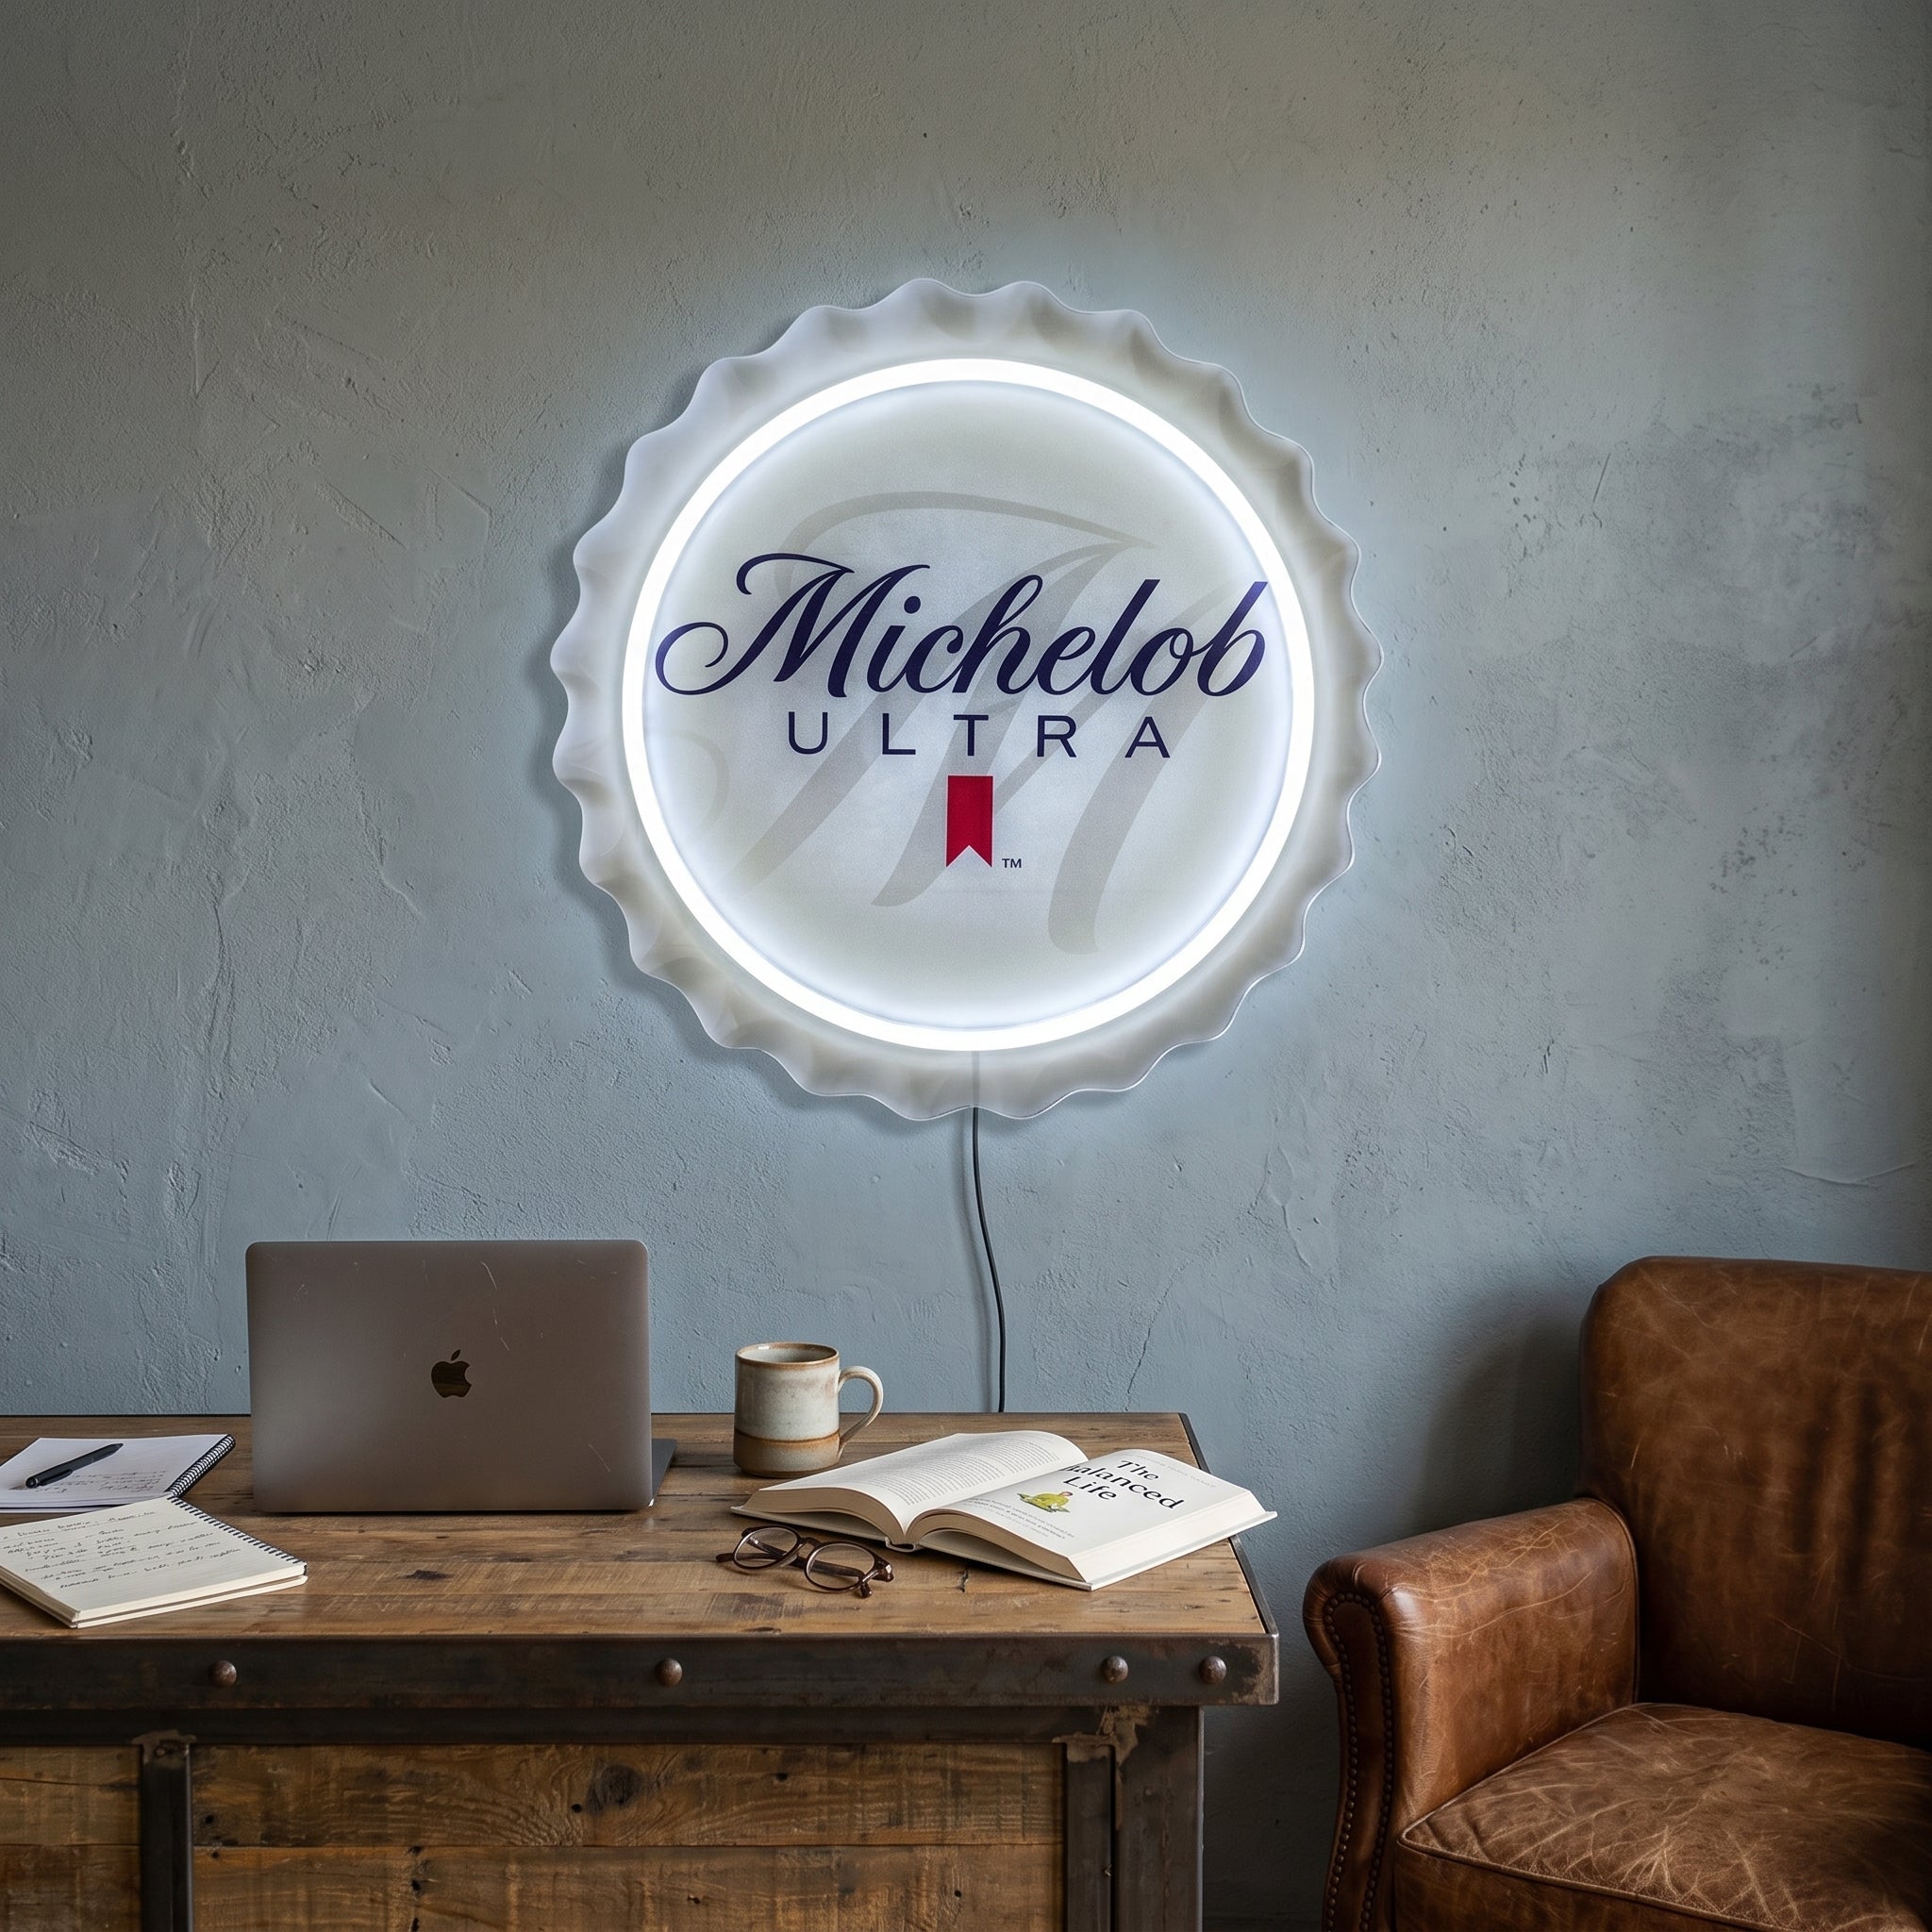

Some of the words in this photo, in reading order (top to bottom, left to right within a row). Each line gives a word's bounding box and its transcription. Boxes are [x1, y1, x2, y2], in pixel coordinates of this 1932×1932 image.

[655, 552, 1268, 698] Michelob
[788, 710, 1171, 758] ULTRA
[1001, 858, 1022, 869] TM
[1116, 1459, 1159, 1481] The
[1062, 1475, 1117, 1500] Life
